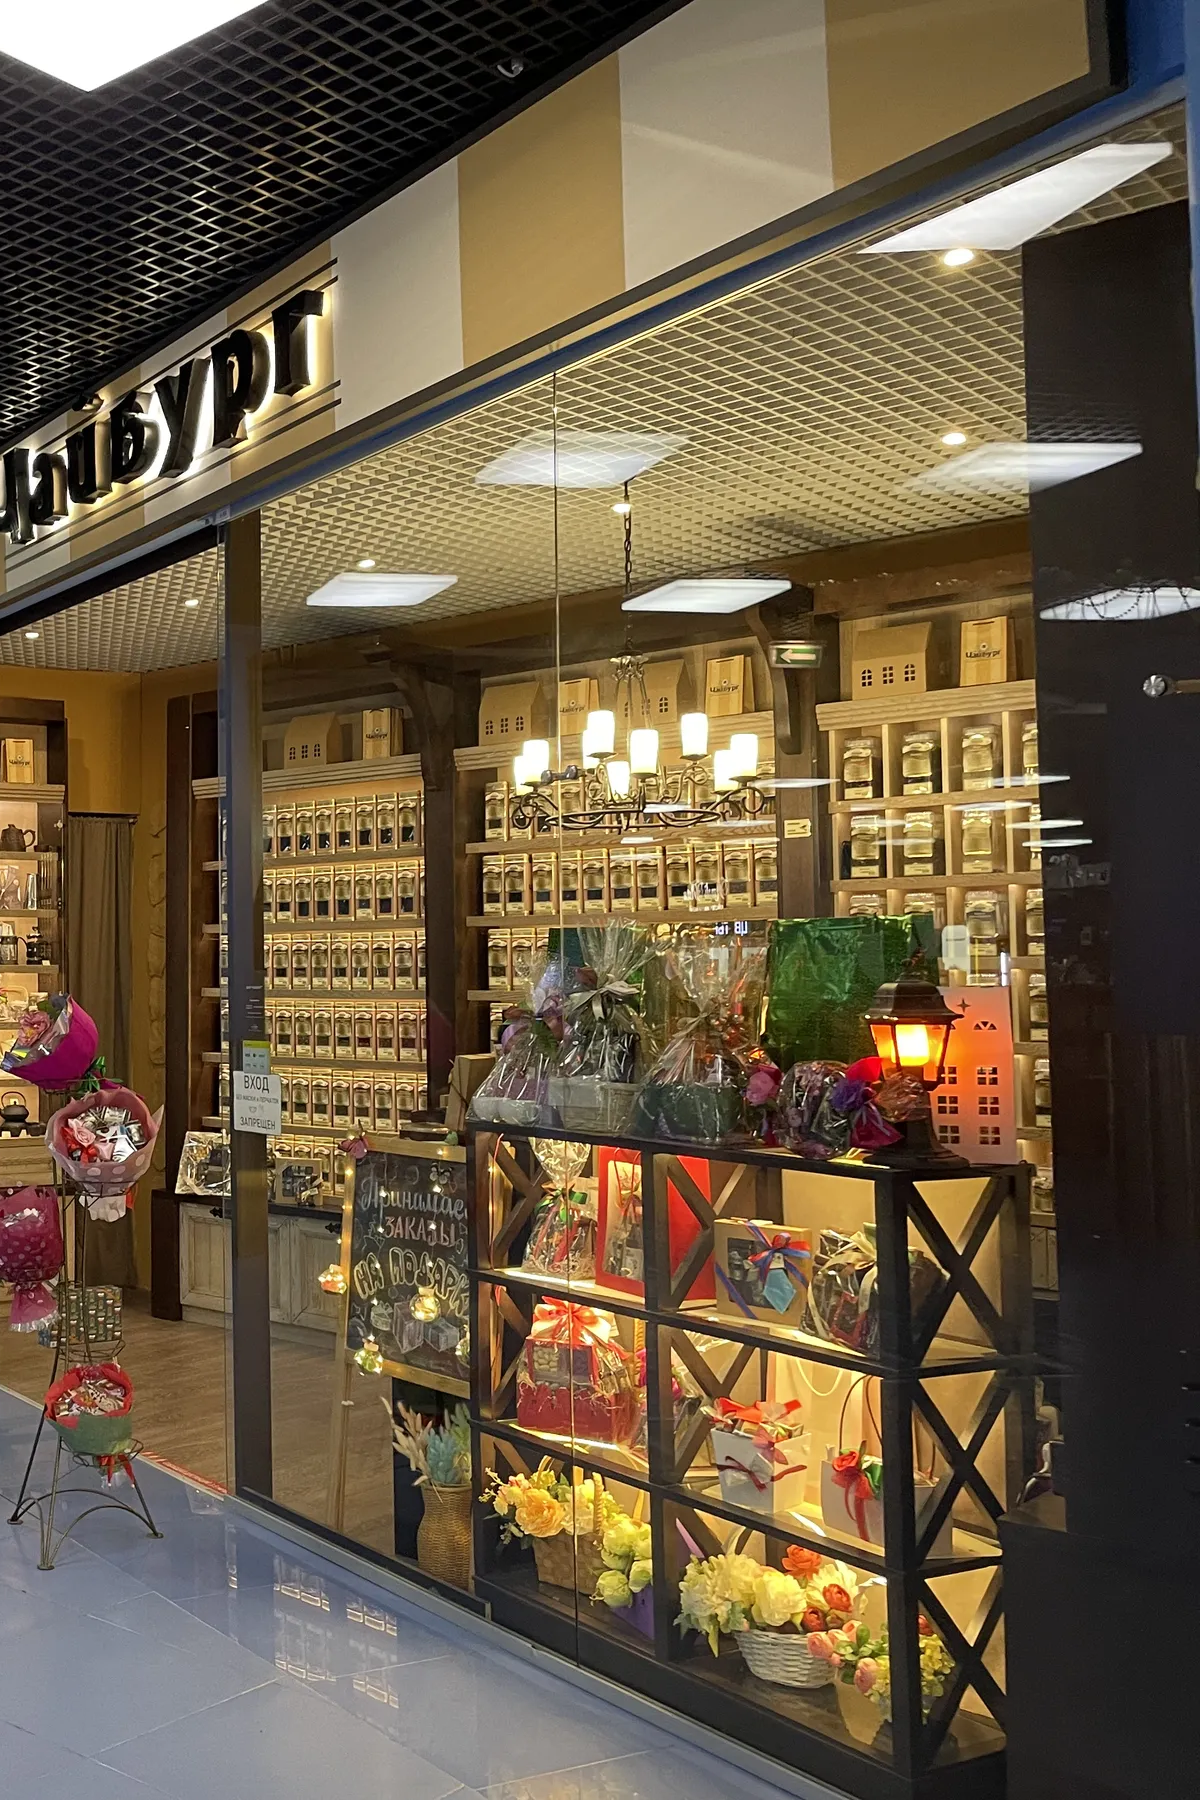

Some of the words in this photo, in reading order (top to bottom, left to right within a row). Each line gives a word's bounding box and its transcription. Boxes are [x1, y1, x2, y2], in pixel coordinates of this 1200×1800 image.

[243, 1075, 270, 1094] ВХОД
[240, 1116, 276, 1131] ЗАПРЕЩЕН
[361, 1170, 468, 1219] Принимае
[354, 1252, 385, 1300] НА
